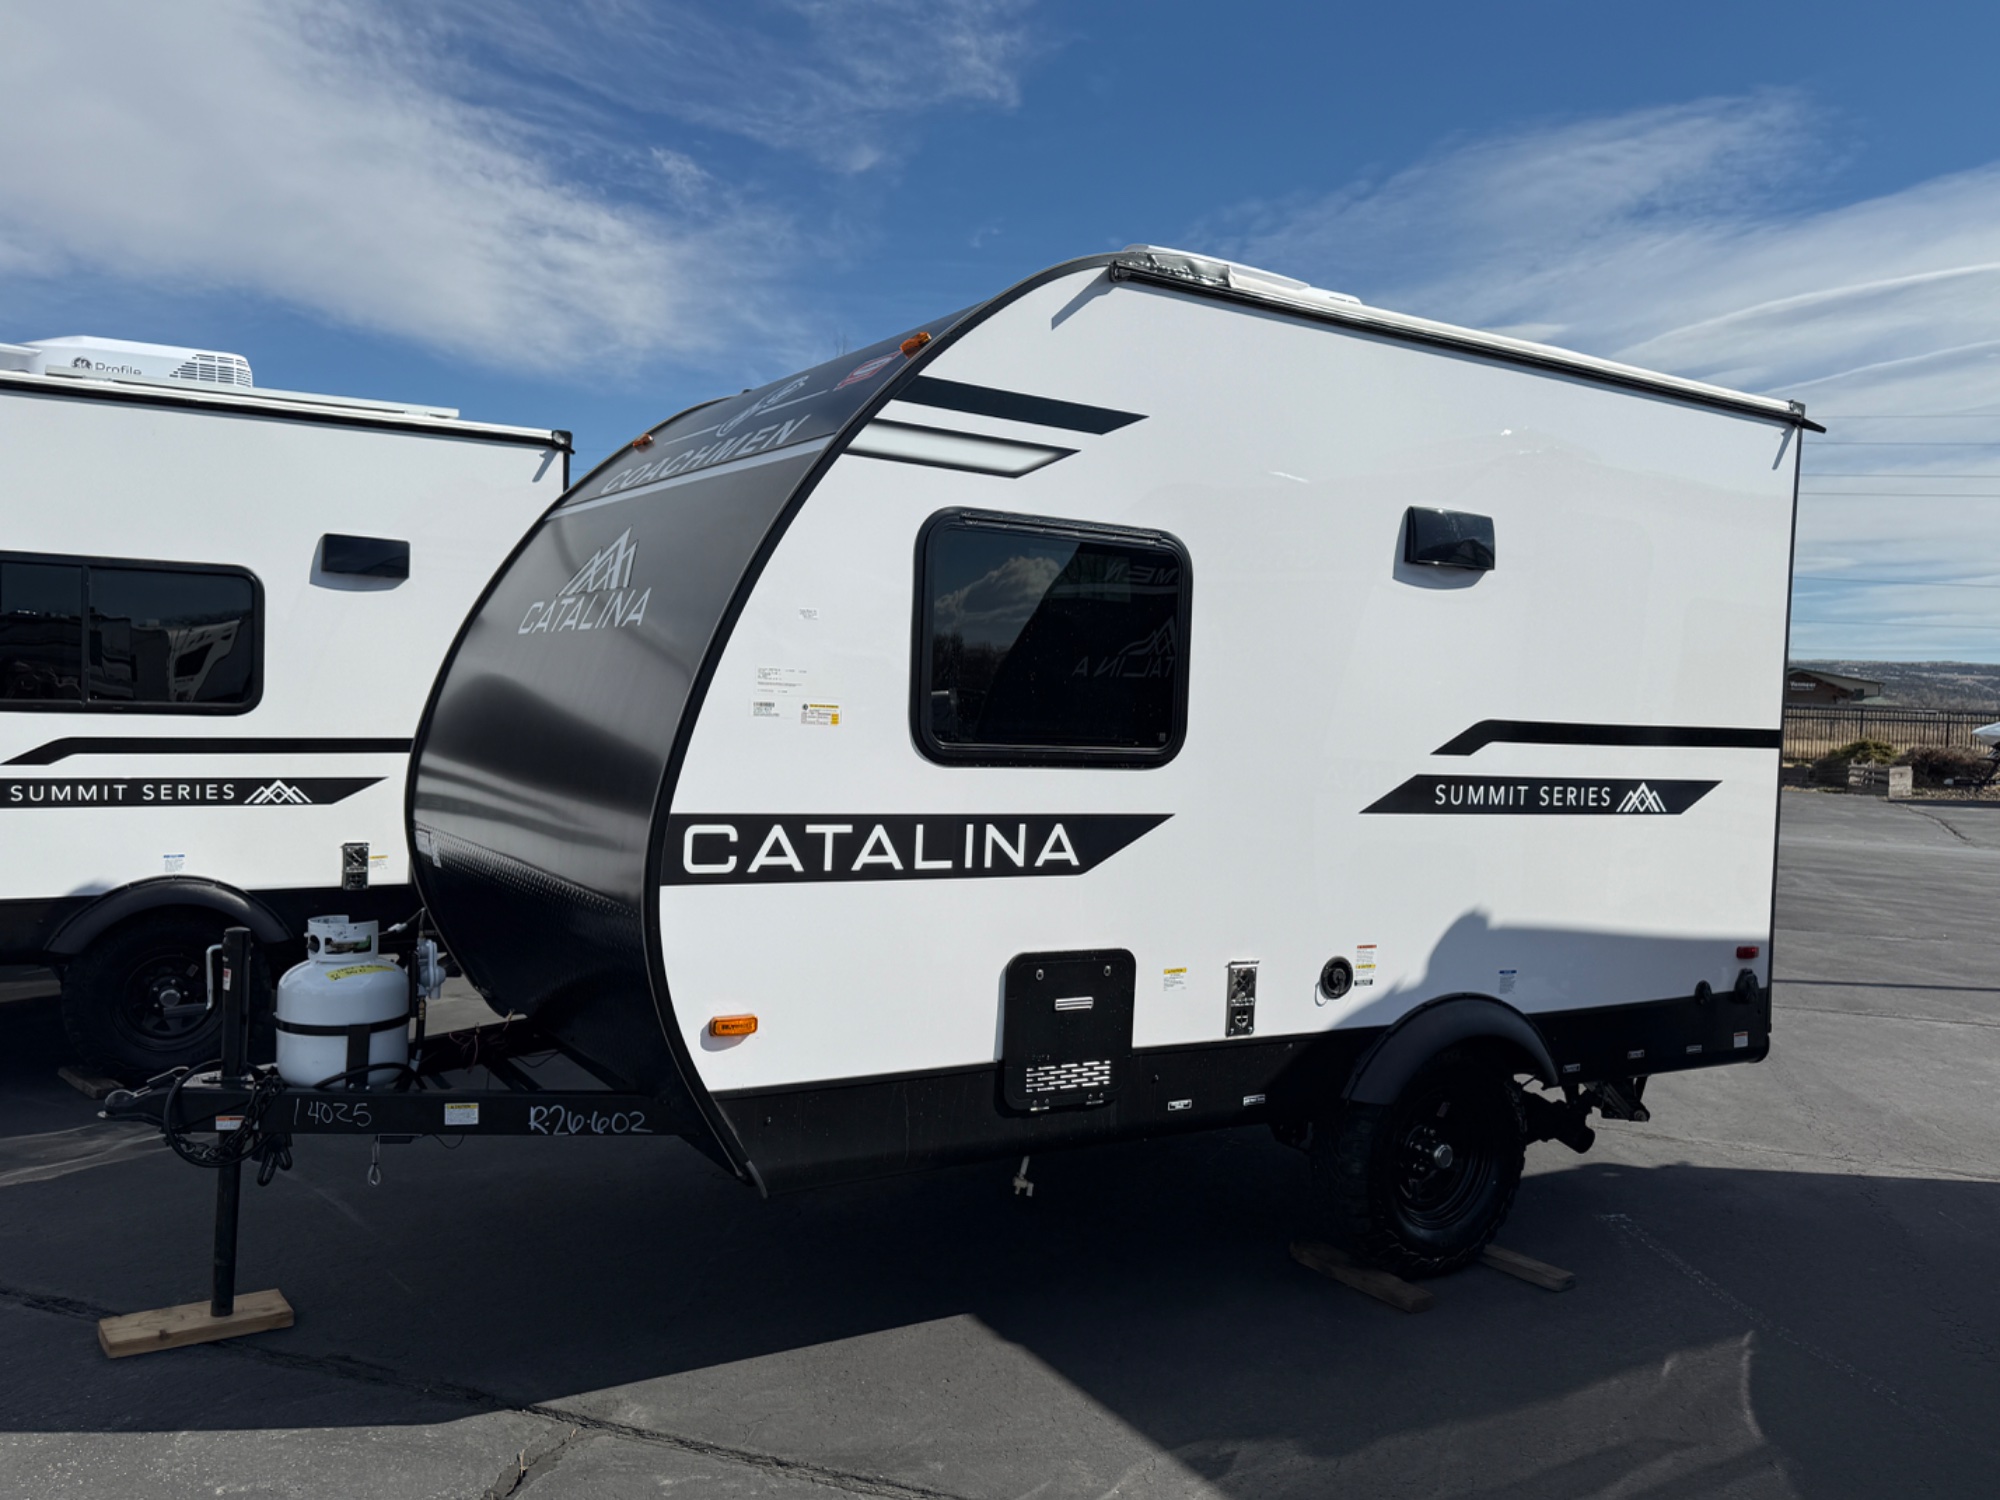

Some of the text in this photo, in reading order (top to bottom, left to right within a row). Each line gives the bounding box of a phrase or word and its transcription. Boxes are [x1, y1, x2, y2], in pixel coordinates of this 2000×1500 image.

[600, 414, 811, 495] COACHMEN
[518, 587, 652, 635] CATALINA
[10, 784, 235, 802] SUMMIT SERIES
[1435, 784, 1611, 806] SUMMIT SERIES
[683, 823, 1080, 874] CATALINA
